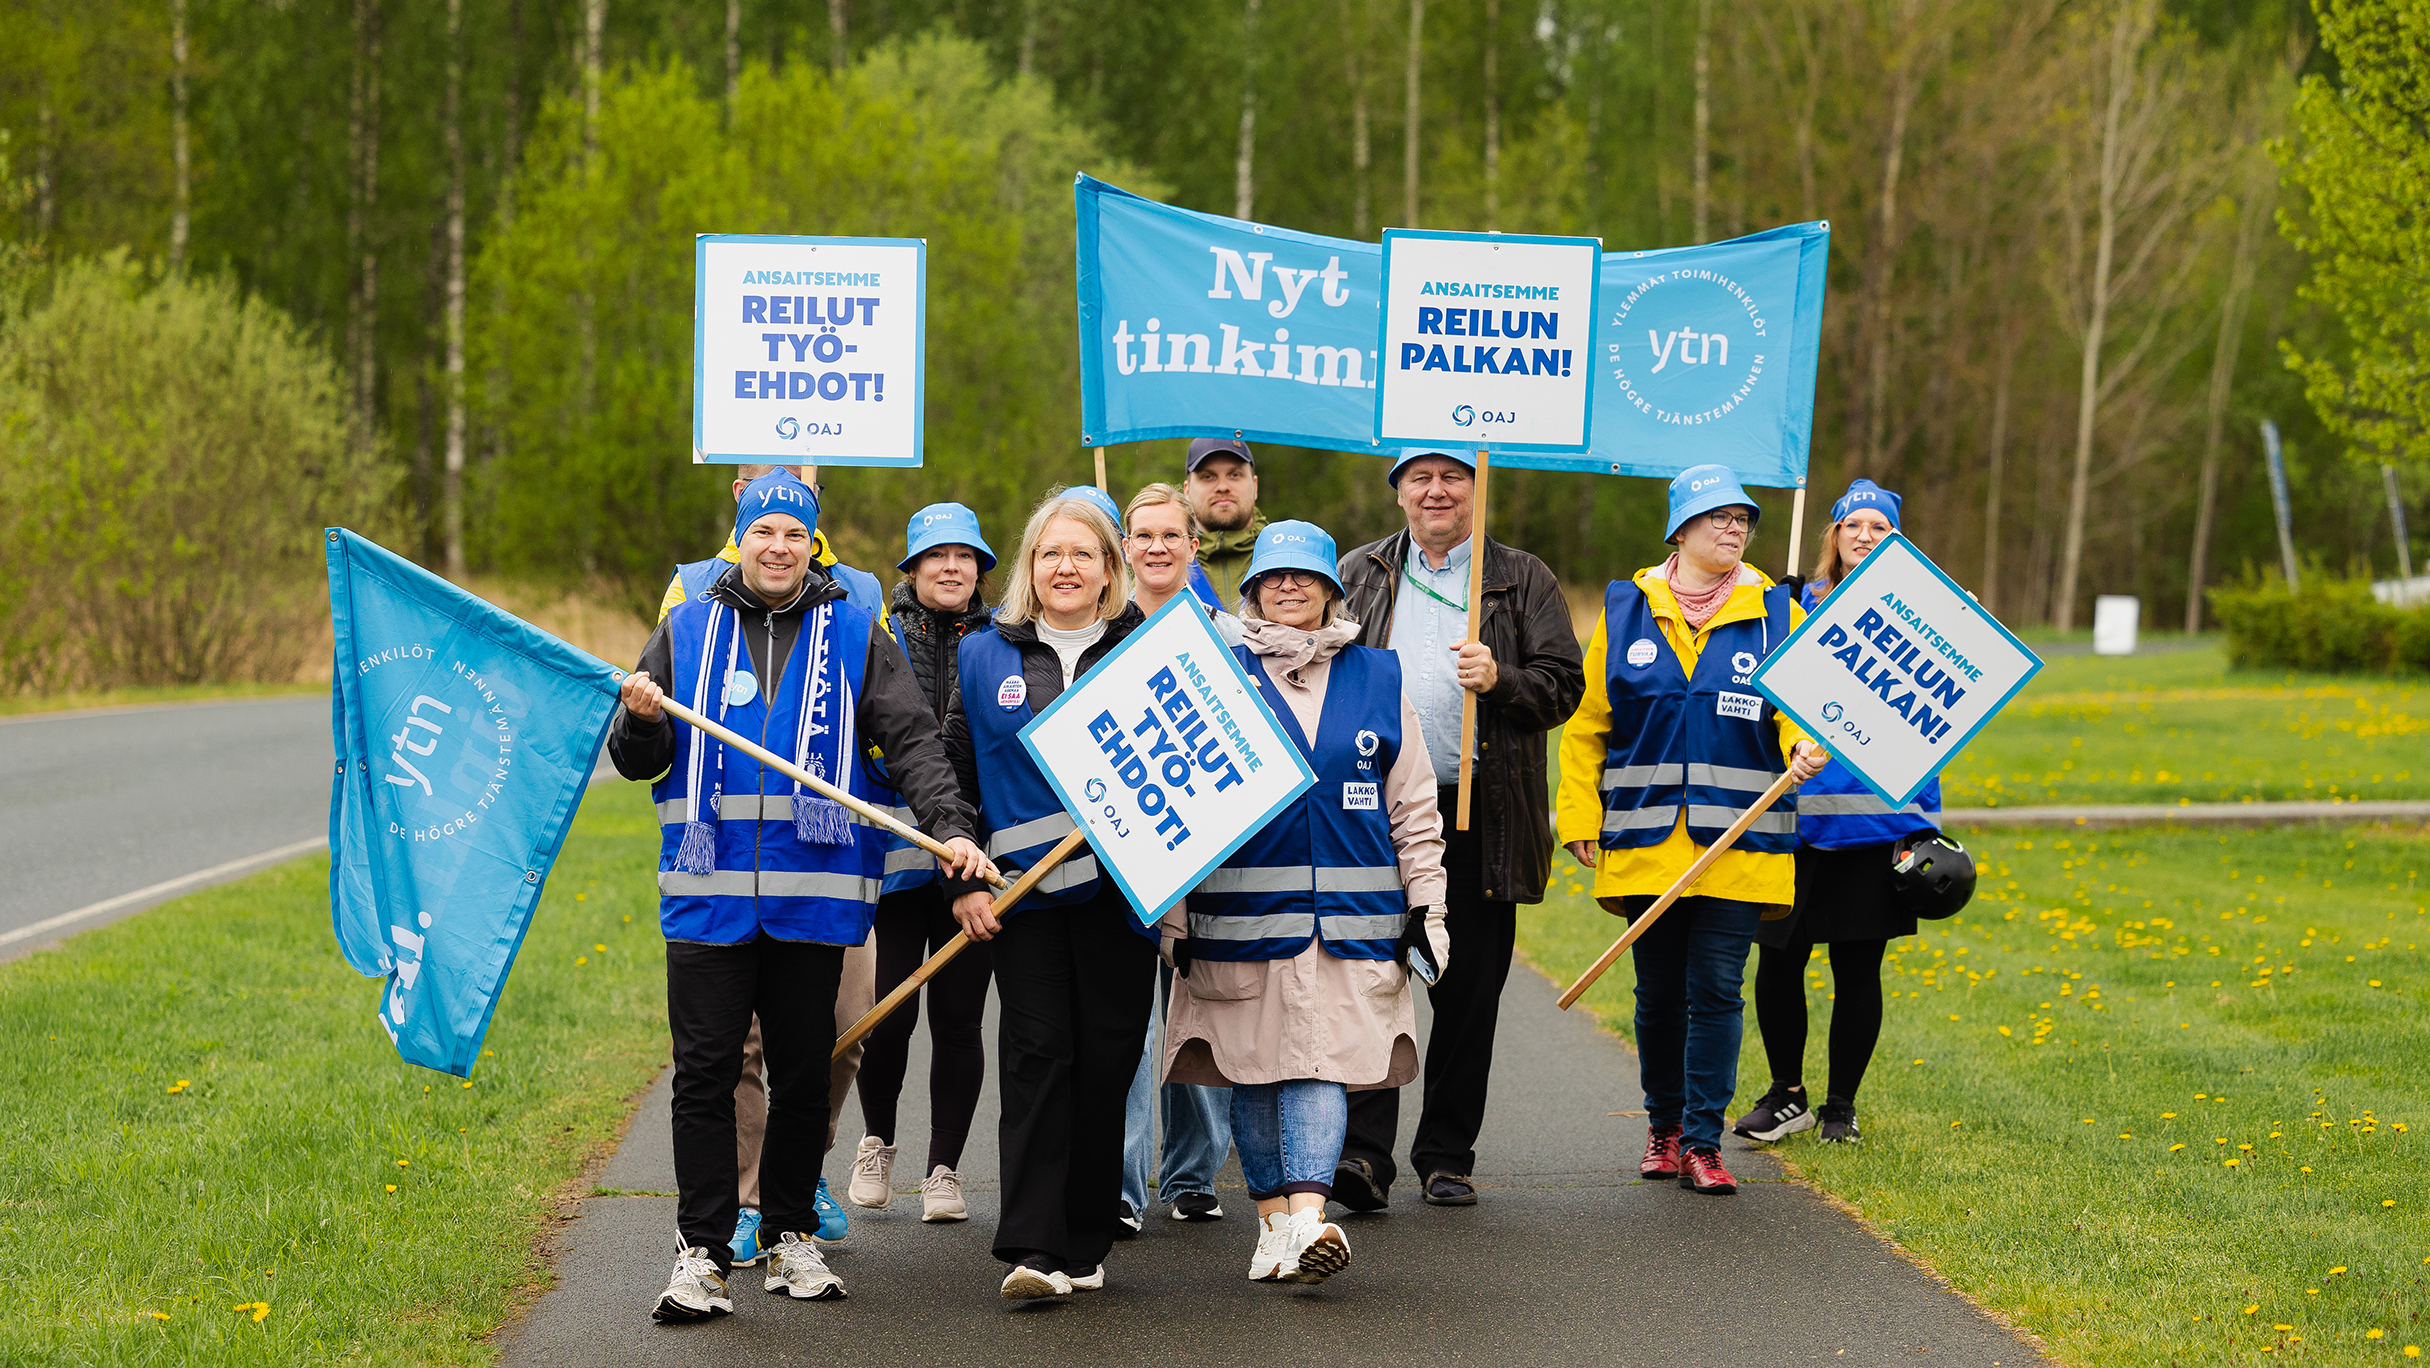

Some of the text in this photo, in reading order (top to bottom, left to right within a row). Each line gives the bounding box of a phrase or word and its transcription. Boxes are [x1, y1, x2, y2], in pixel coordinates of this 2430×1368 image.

[742, 270, 881, 287] ANSAITSEMME
[1207, 245, 1350, 319] Nyt
[1420, 281, 1560, 300] ANSAITSEMME
[742, 295, 880, 326] REILUT
[1611, 269, 1767, 338] YLEMMÄT TOIMIHENKILÖT
[1418, 306, 1559, 340] REILUN
[762, 326, 858, 363] TYÖ-
[1400, 342, 1573, 378] PALKAN!
[1648, 326, 1729, 375] ytn
[734, 370, 885, 402] EHDOT!
[1608, 344, 1765, 426] DE HÖGRE TJÄNSTEMÄNNEN
[806, 422, 842, 436] OAJ
[1481, 410, 1516, 424] OAJ
[757, 484, 803, 509] ytn
[1703, 476, 1720, 486] OAJ
[1842, 491, 1877, 513] ytn
[1287, 534, 1306, 543] OAJ
[1880, 591, 1983, 683] ANSAITSEMME
[358, 643, 436, 677] ENKILÖT
[1853, 606, 1966, 710] REILUN
[1816, 622, 1952, 745] PALKAN!
[1175, 651, 1264, 774] ANSAITSEMME
[1721, 704, 1751, 716] VAHTI
[1722, 695, 1759, 707] LAKKO-
[384, 694, 452, 797] ytn
[1146, 665, 1245, 793] REILUT
[1843, 720, 1872, 746] OAJ
[389, 821, 406, 840] DE
[414, 810, 477, 842] HÖGRE
[452, 660, 513, 810] TJÄNSTEMÄNNEN
[1132, 706, 1197, 798] TYÖ-
[1356, 760, 1372, 771] OAJ
[1087, 708, 1192, 851] EHDOT!
[1347, 786, 1377, 795] LAKKO-
[1347, 797, 1372, 806] VAHTI
[1103, 804, 1131, 838] OAJ
